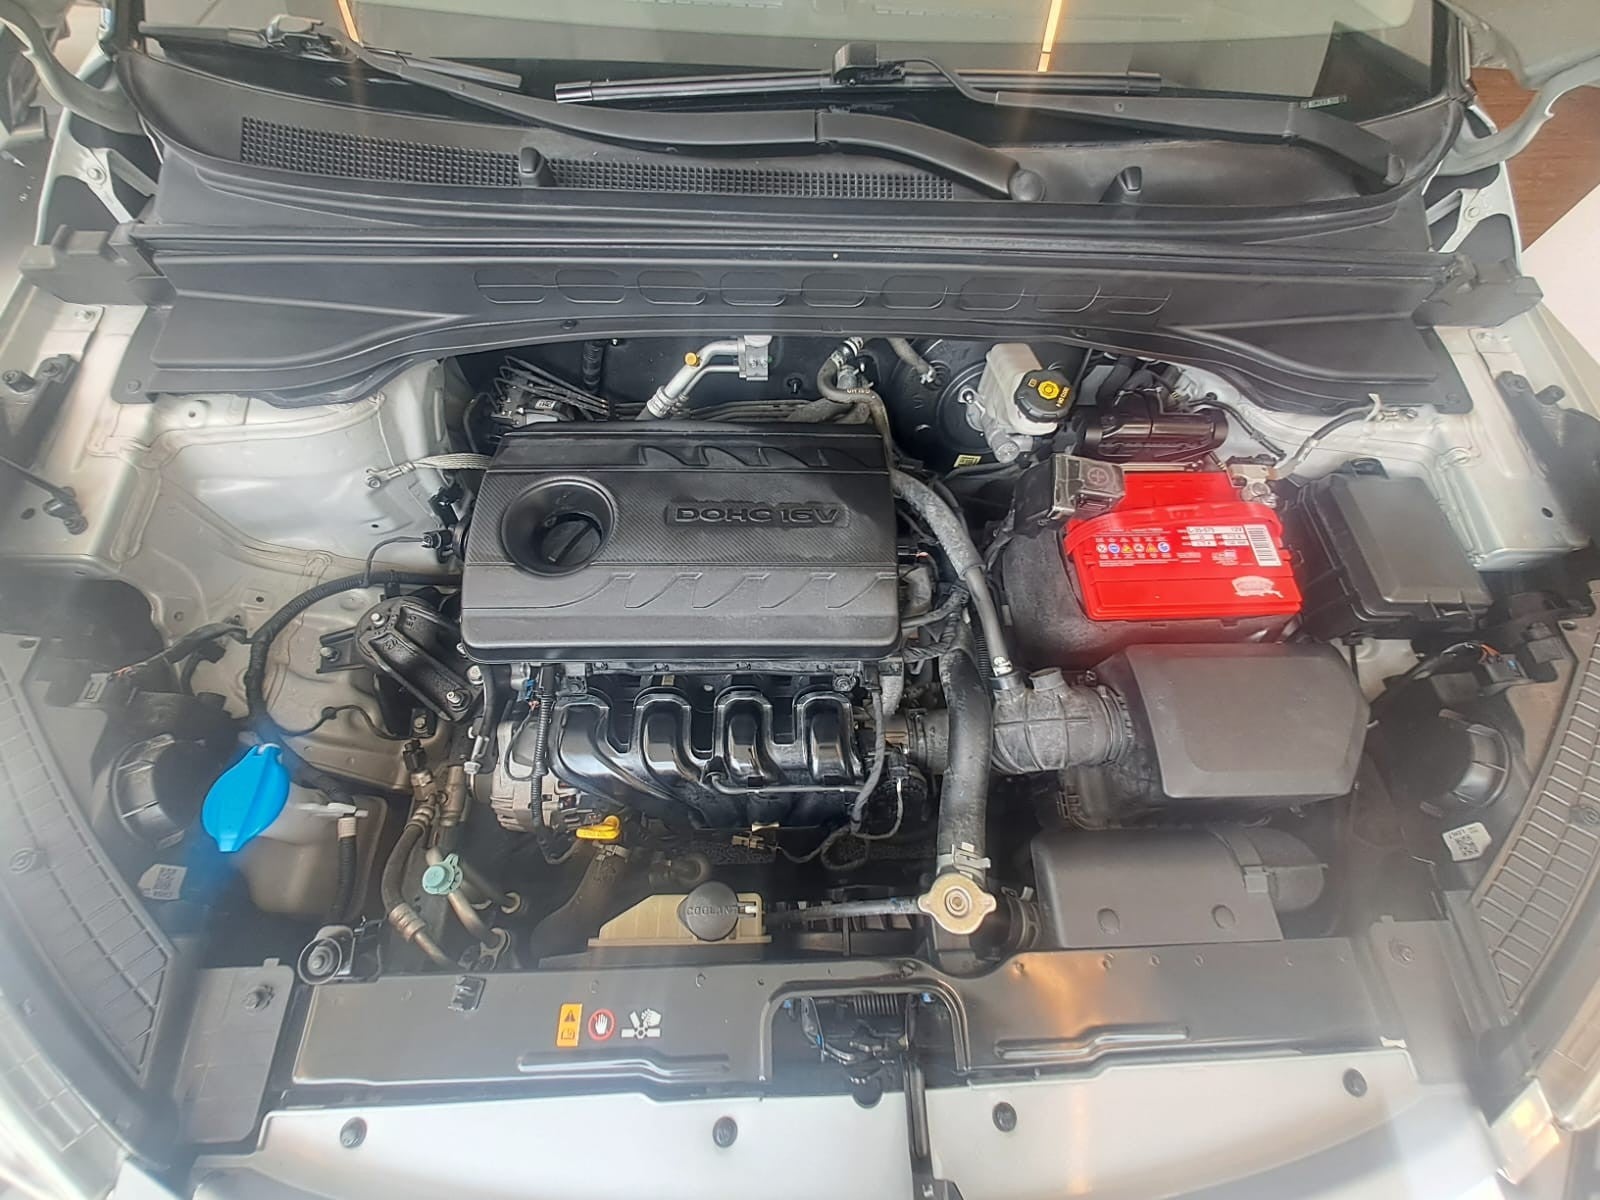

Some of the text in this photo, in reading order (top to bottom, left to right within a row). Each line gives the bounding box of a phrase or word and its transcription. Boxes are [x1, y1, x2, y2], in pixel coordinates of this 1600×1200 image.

[675, 507, 839, 524] DOHC 16V
[686, 905, 738, 916] COOLANT
